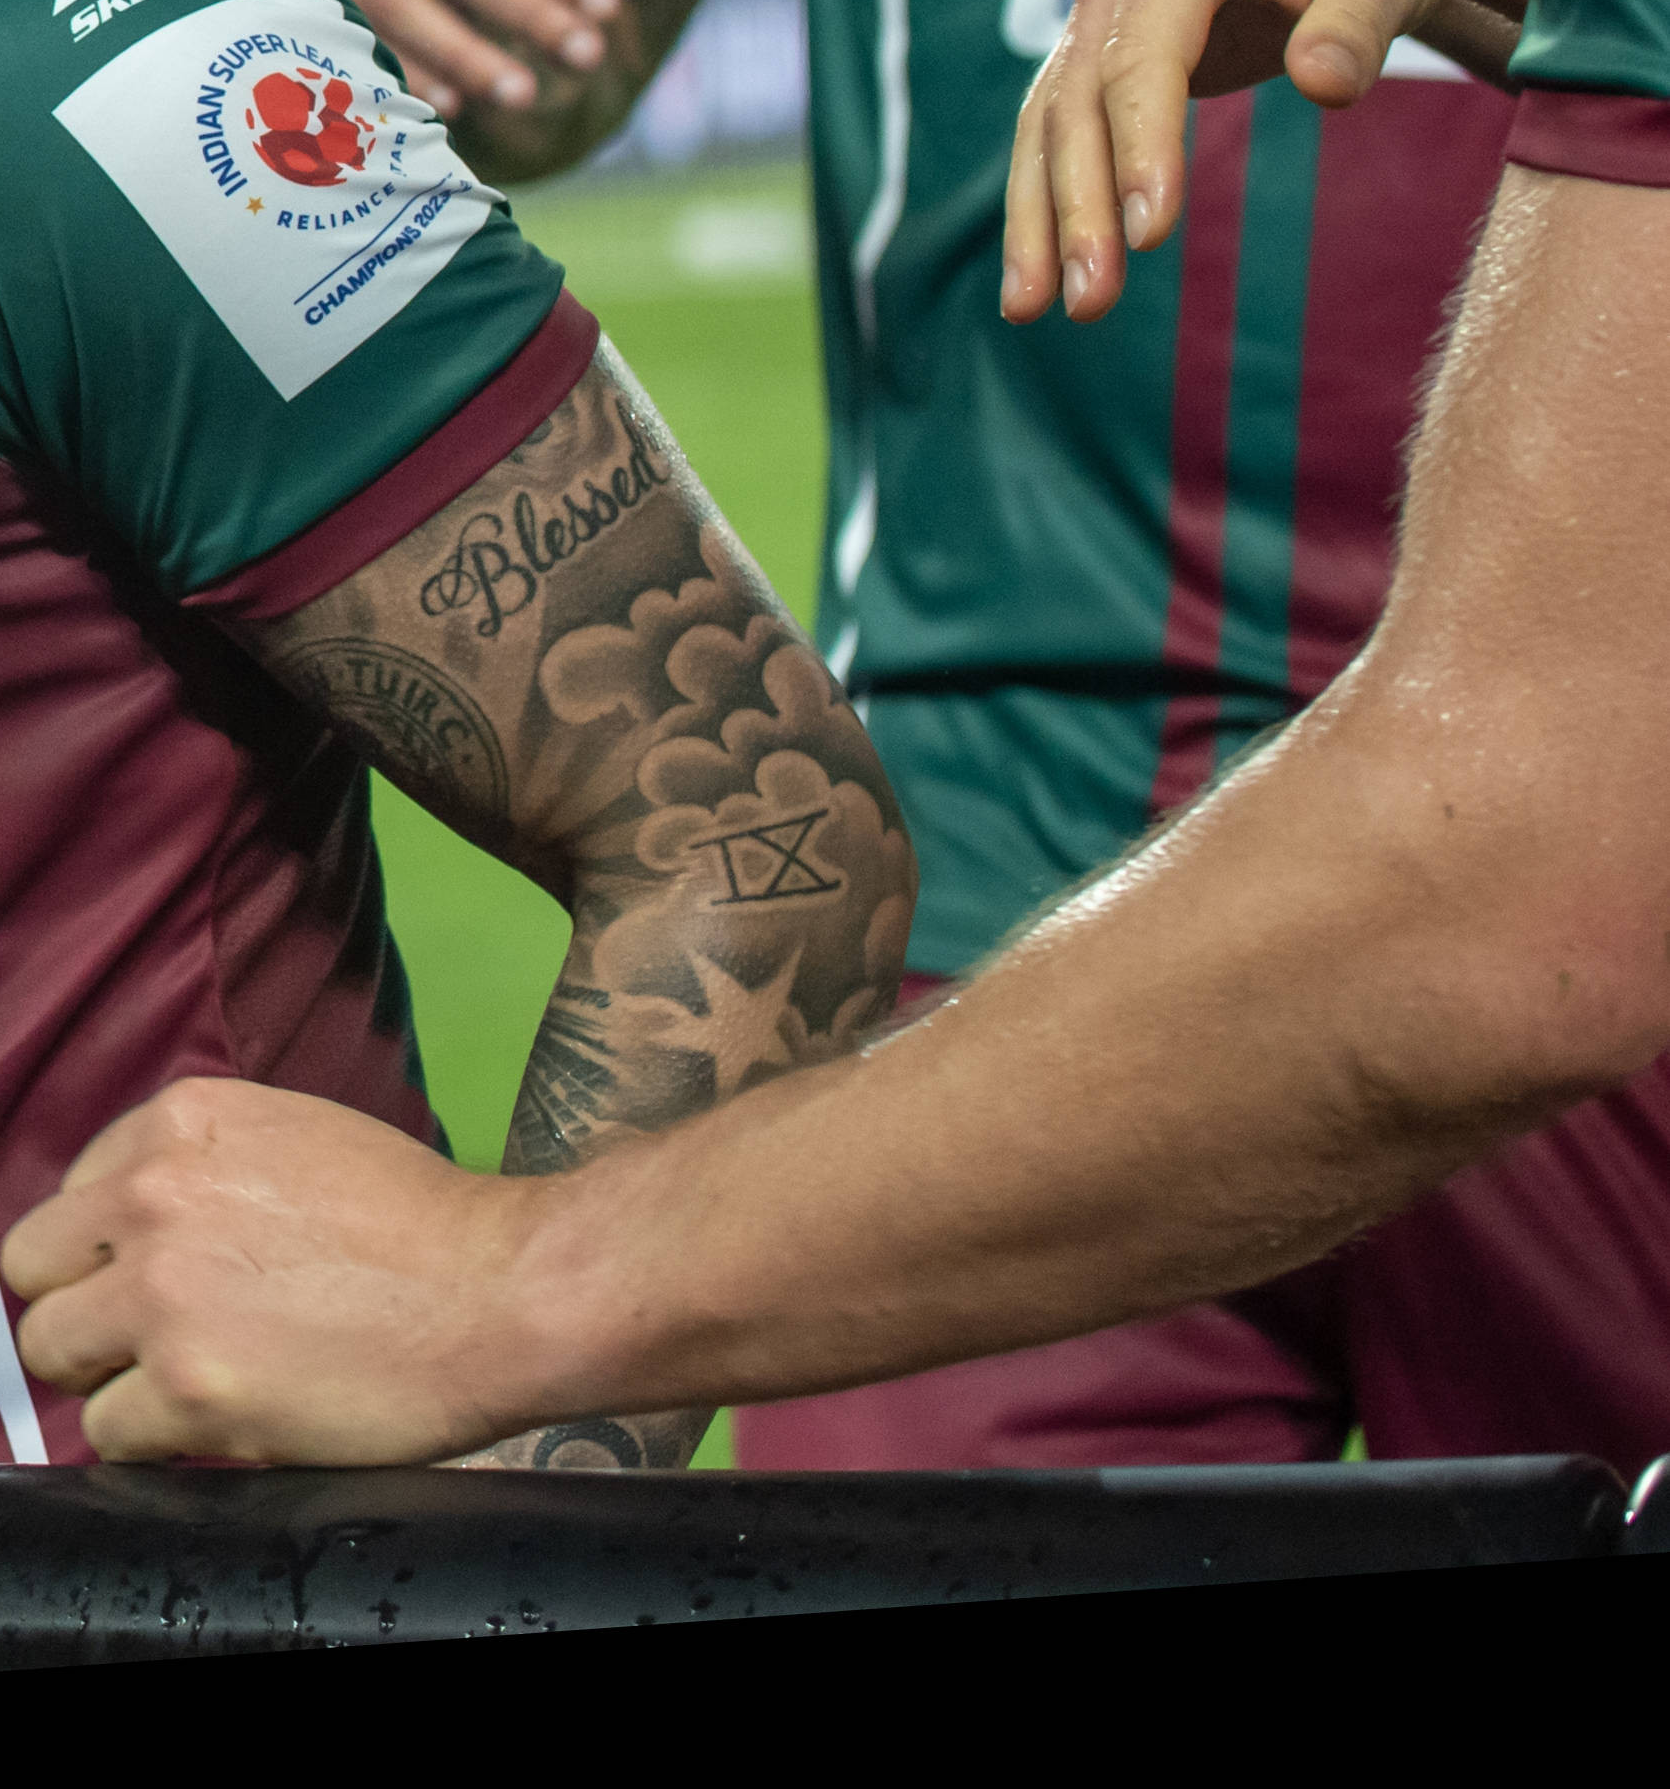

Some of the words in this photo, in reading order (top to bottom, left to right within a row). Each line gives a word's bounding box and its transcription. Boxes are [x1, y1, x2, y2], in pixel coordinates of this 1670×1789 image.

[209, 33, 289, 83] SUPER
[196, 84, 249, 197] INDIAN
[277, 181, 397, 230] RELIANCE
[304, 225, 422, 326] CHAMPIONS
[420, 399, 670, 638] Blessed
